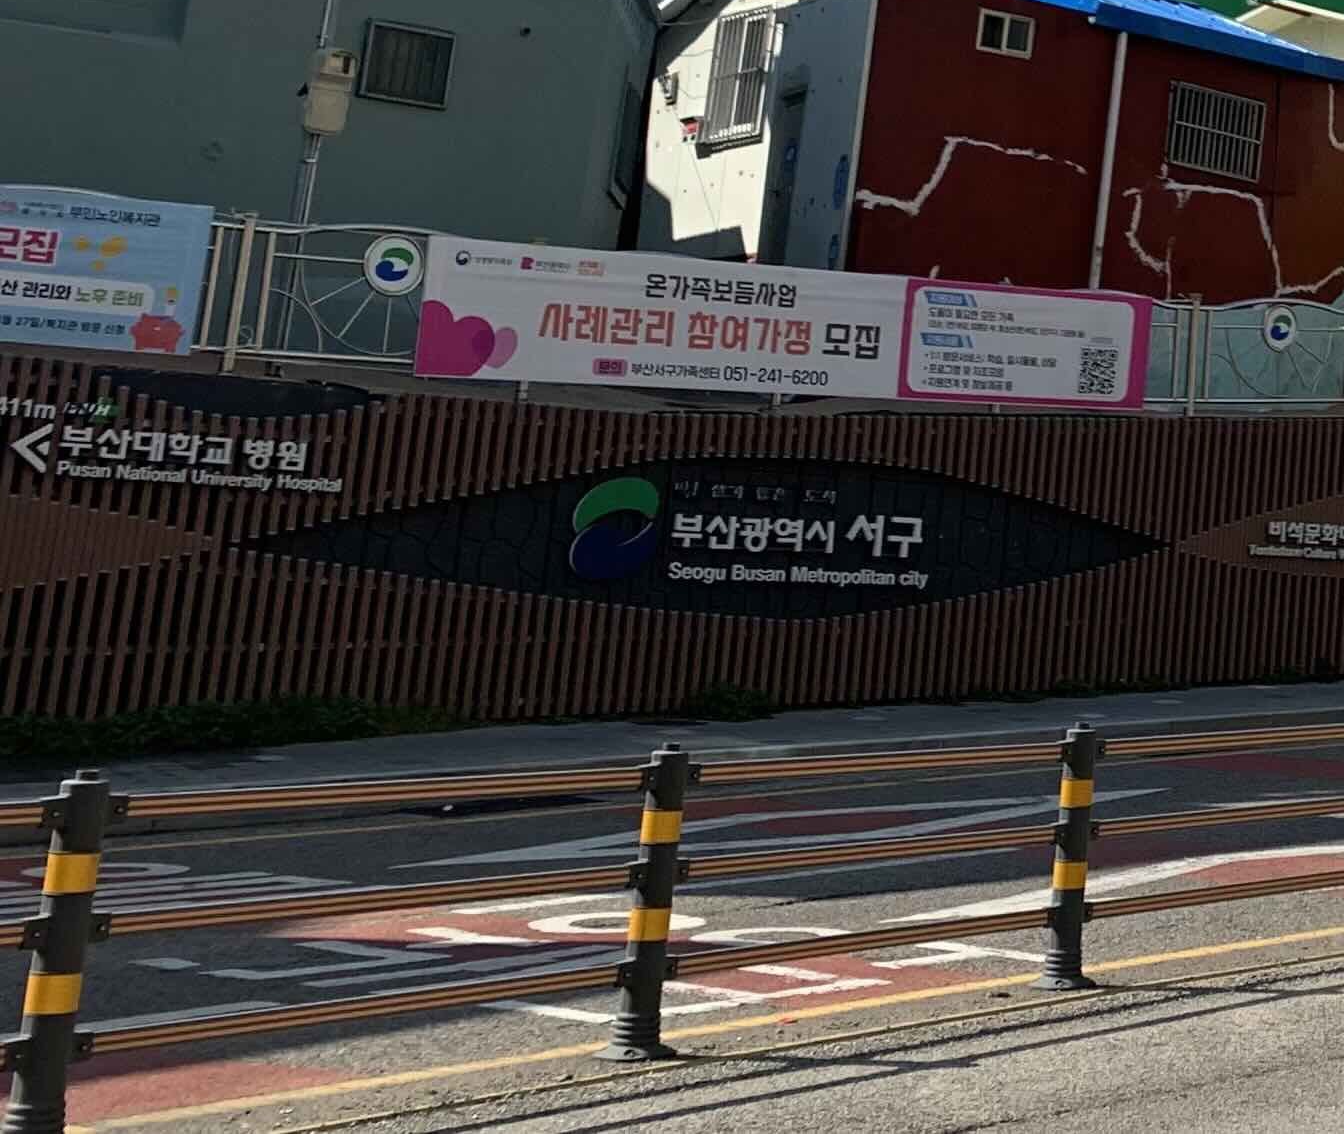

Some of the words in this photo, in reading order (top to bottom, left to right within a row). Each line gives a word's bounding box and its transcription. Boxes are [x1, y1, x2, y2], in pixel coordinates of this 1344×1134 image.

[22, 281, 72, 301] 관리와
[645, 273, 797, 309] 온가족보듬사업
[537, 302, 676, 348] 사례관리
[687, 311, 811, 356] 참여가정
[822, 322, 881, 360] 모집
[724, 365, 829, 387] 051-241-6200
[60, 425, 233, 465] 부산대학교
[242, 438, 308, 473] 병원
[56, 461, 112, 480] Pusan
[115, 465, 187, 484] National
[191, 469, 274, 491] University
[277, 473, 342, 494] Hospital
[671, 513, 835, 554] 부산광역시
[845, 514, 924, 558] 서구
[668, 562, 727, 584] Seogu
[730, 564, 786, 583] Busan
[790, 566, 896, 588] Metropolitan
[898, 570, 929, 589] city
